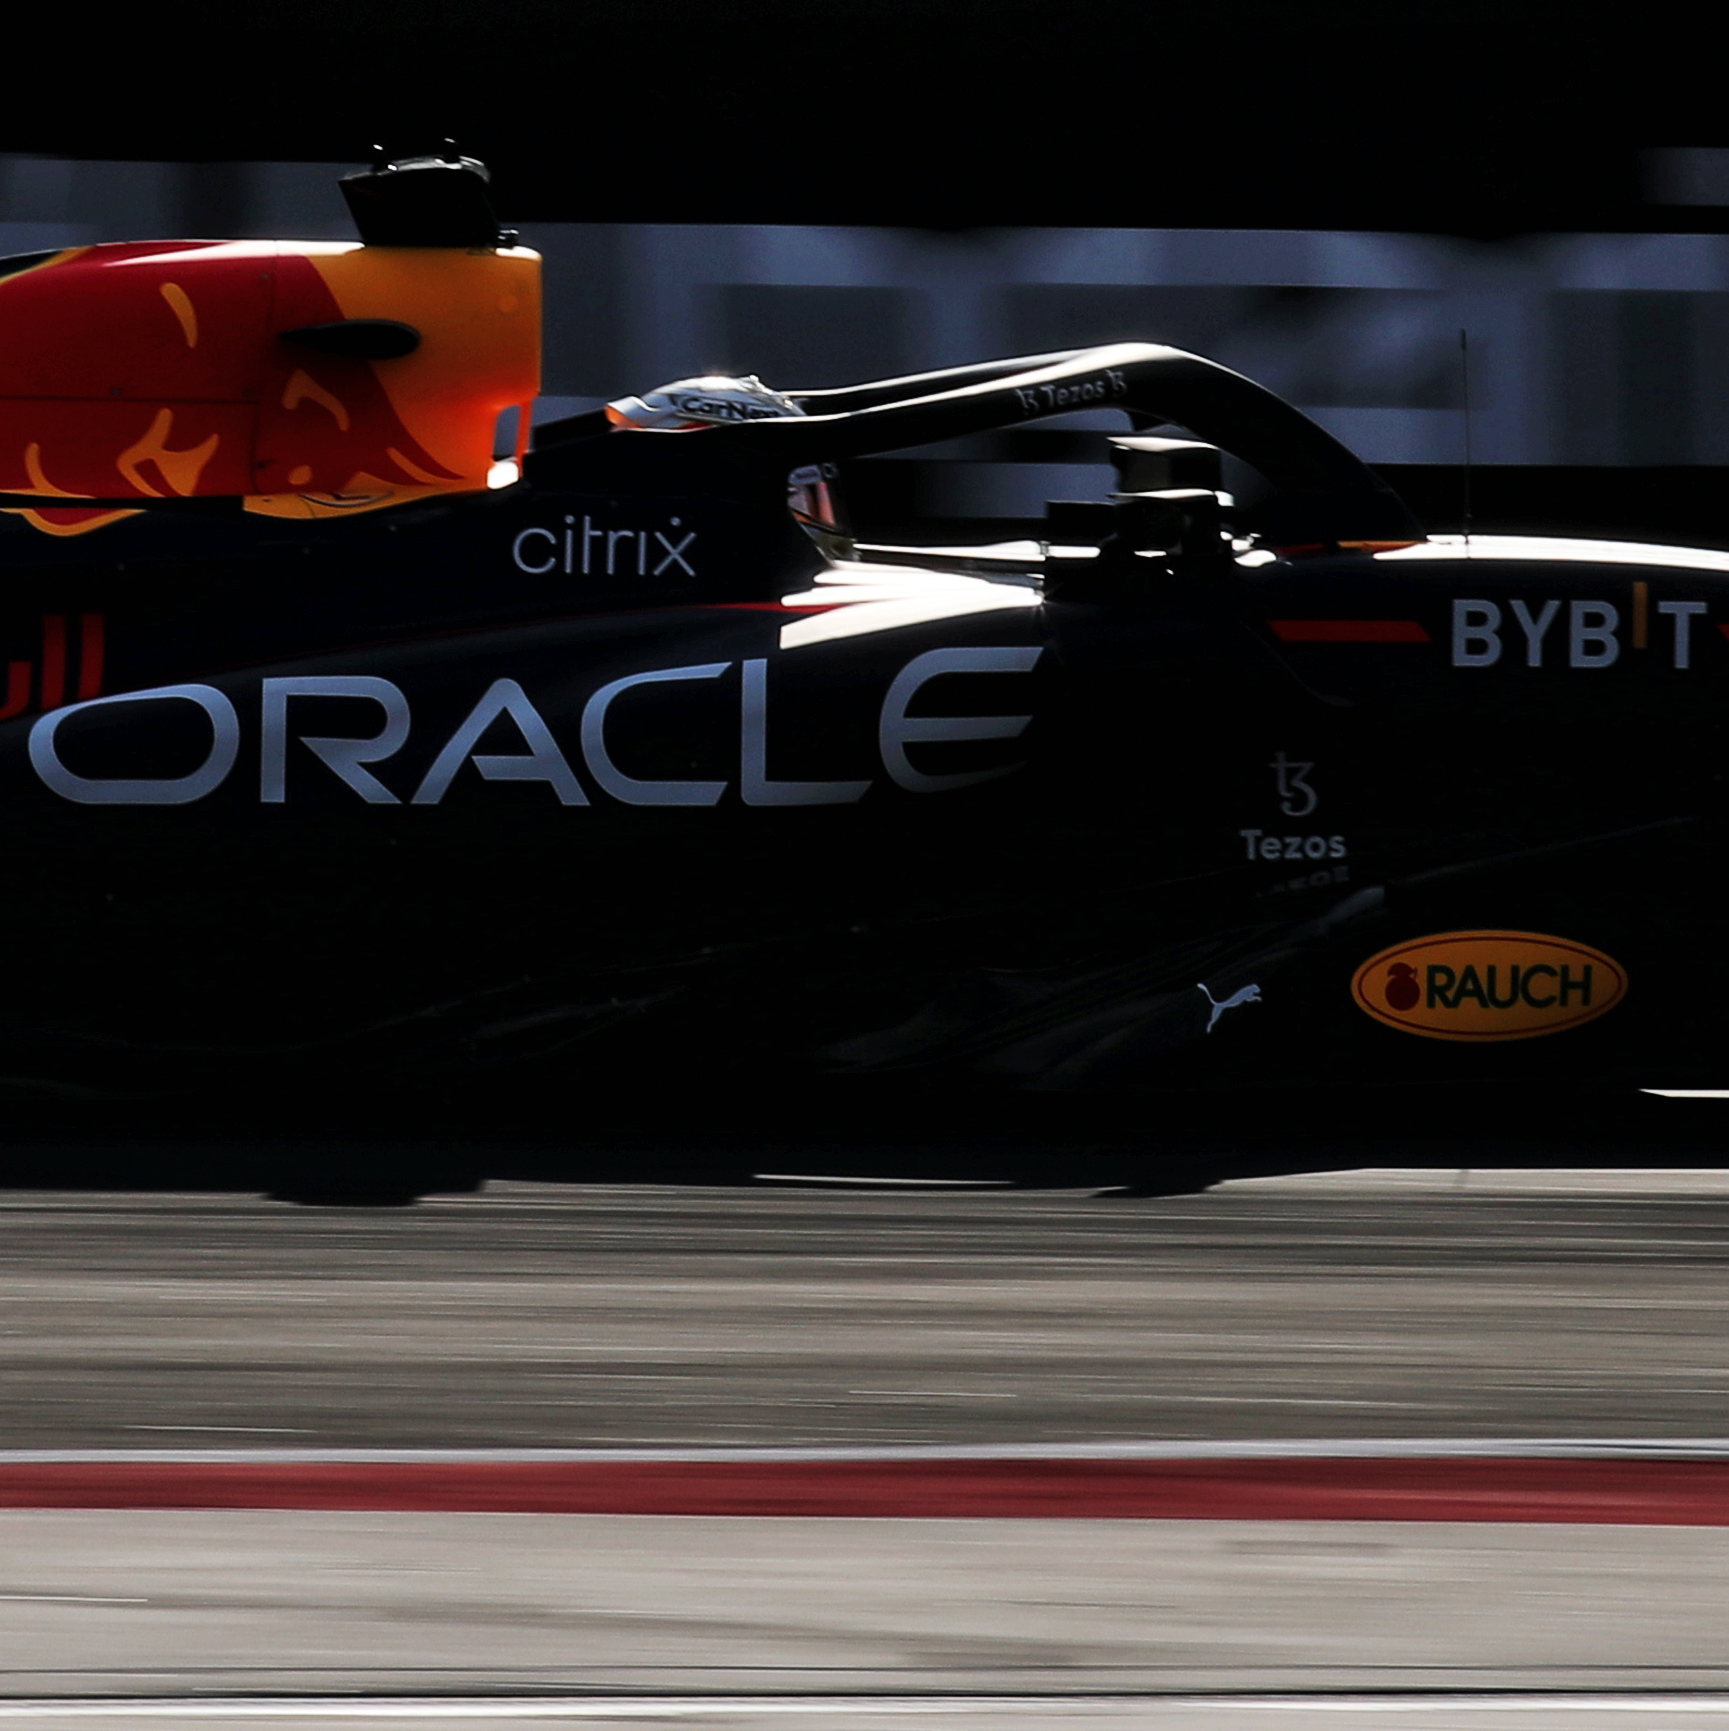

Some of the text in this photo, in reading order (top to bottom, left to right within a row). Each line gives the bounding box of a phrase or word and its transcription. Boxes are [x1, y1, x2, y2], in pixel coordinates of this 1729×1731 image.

[1039, 381, 1106, 409] Tezos
[511, 514, 698, 579] citrix
[1450, 580, 1709, 669] BYBIT
[27, 645, 1045, 807] ORACLE
[1238, 828, 1348, 861] Tezos
[1425, 964, 1592, 1008] RAUCH
